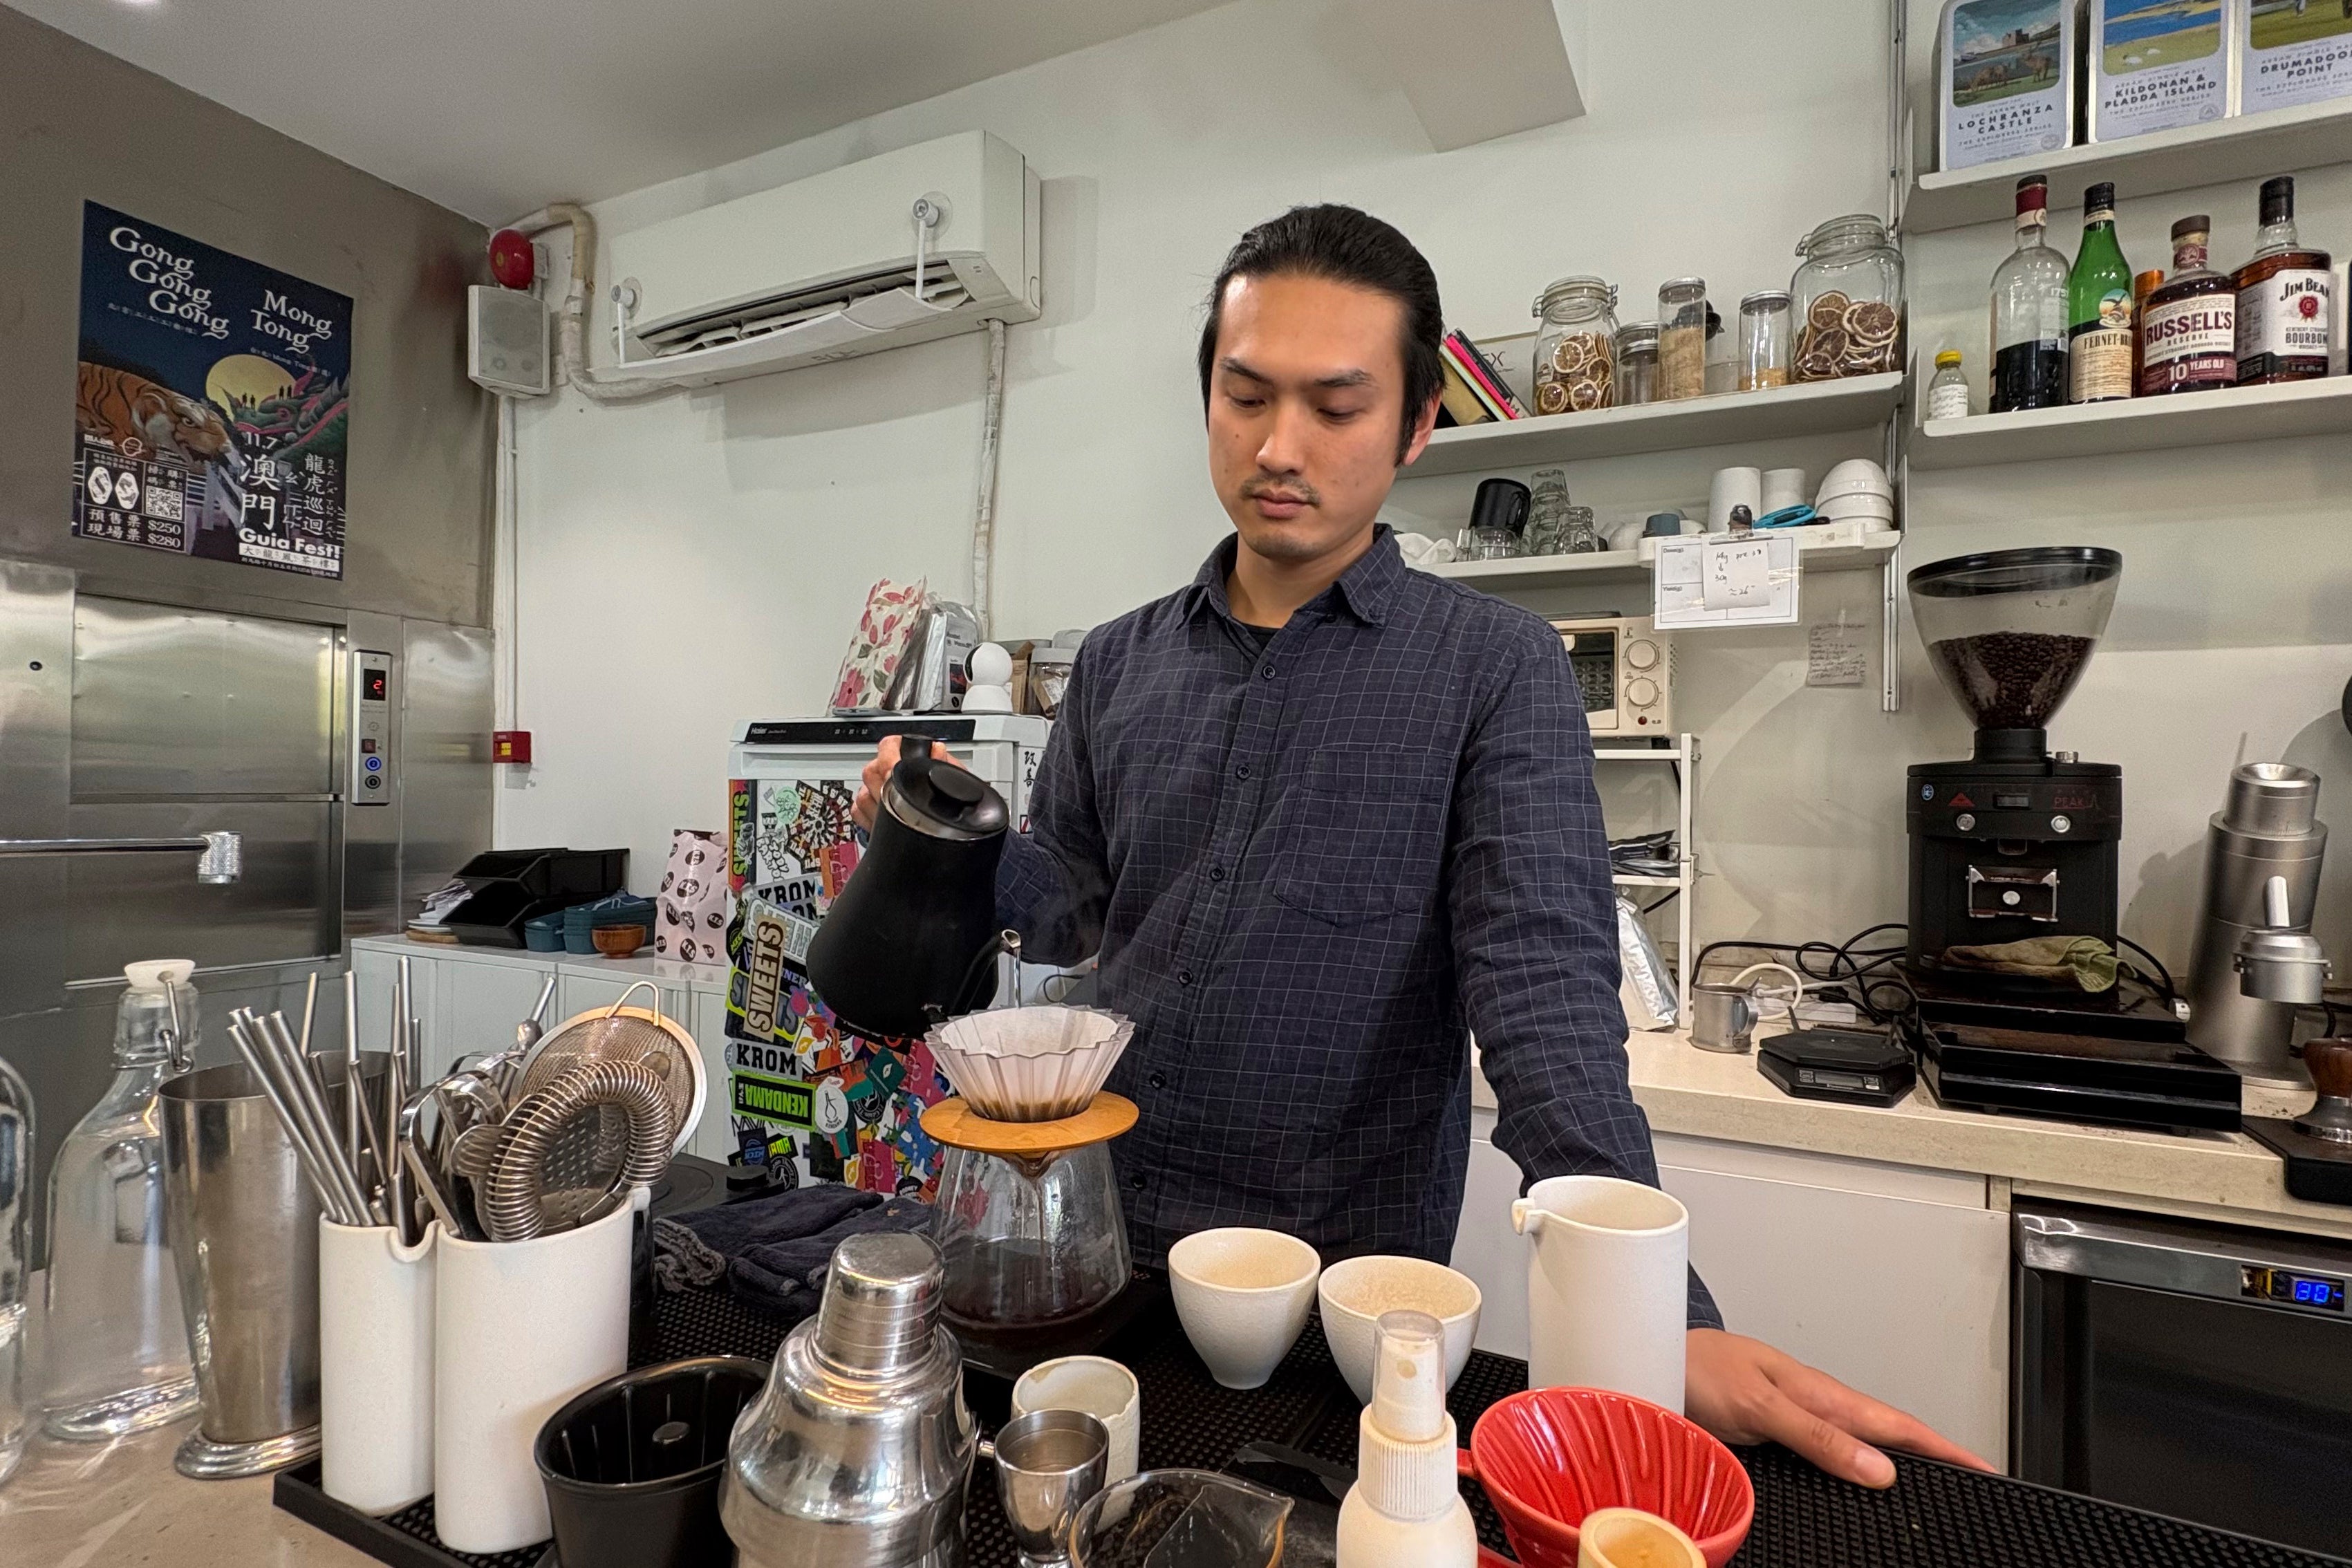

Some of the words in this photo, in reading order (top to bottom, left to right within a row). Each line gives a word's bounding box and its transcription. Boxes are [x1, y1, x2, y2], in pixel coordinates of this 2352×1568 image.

[2287, 63, 2333, 79] POINT
[2104, 92, 2158, 109] PLADDA
[2165, 82, 2216, 97] ISLAND
[2116, 77, 2189, 97] KILDONAN
[1959, 104, 2053, 130] LOCHRANZA
[1978, 117, 2032, 134] CASTLE
[110, 227, 194, 279] Gong
[129, 259, 212, 308] Gong
[2280, 282, 2304, 301] JIM
[149, 290, 229, 339] Gong
[263, 289, 333, 339] Mong
[251, 309, 309, 354] Tong
[2146, 311, 2232, 346] RUSSELL'S
[2167, 333, 2209, 347] RESERVE
[2168, 364, 2188, 382] 10
[2190, 360, 2212, 371] YEARS
[2212, 359, 2224, 368] OLD
[246, 432, 278, 449] 11.7
[239, 454, 281, 531] 澳門
[301, 453, 326, 535] 龍虎巡迴
[87, 523, 141, 541] 現場票
[148, 534, 181, 548] $280
[88, 509, 141, 528] 預售票
[148, 520, 181, 535] $250
[239, 528, 290, 550] Guia
[295, 538, 340, 559] Fest!
[373, 680, 382, 690] 2
[747, 921, 783, 1033] SWEETS
[737, 1043, 796, 1075] KROM
[745, 1084, 809, 1118] KENDAMA
